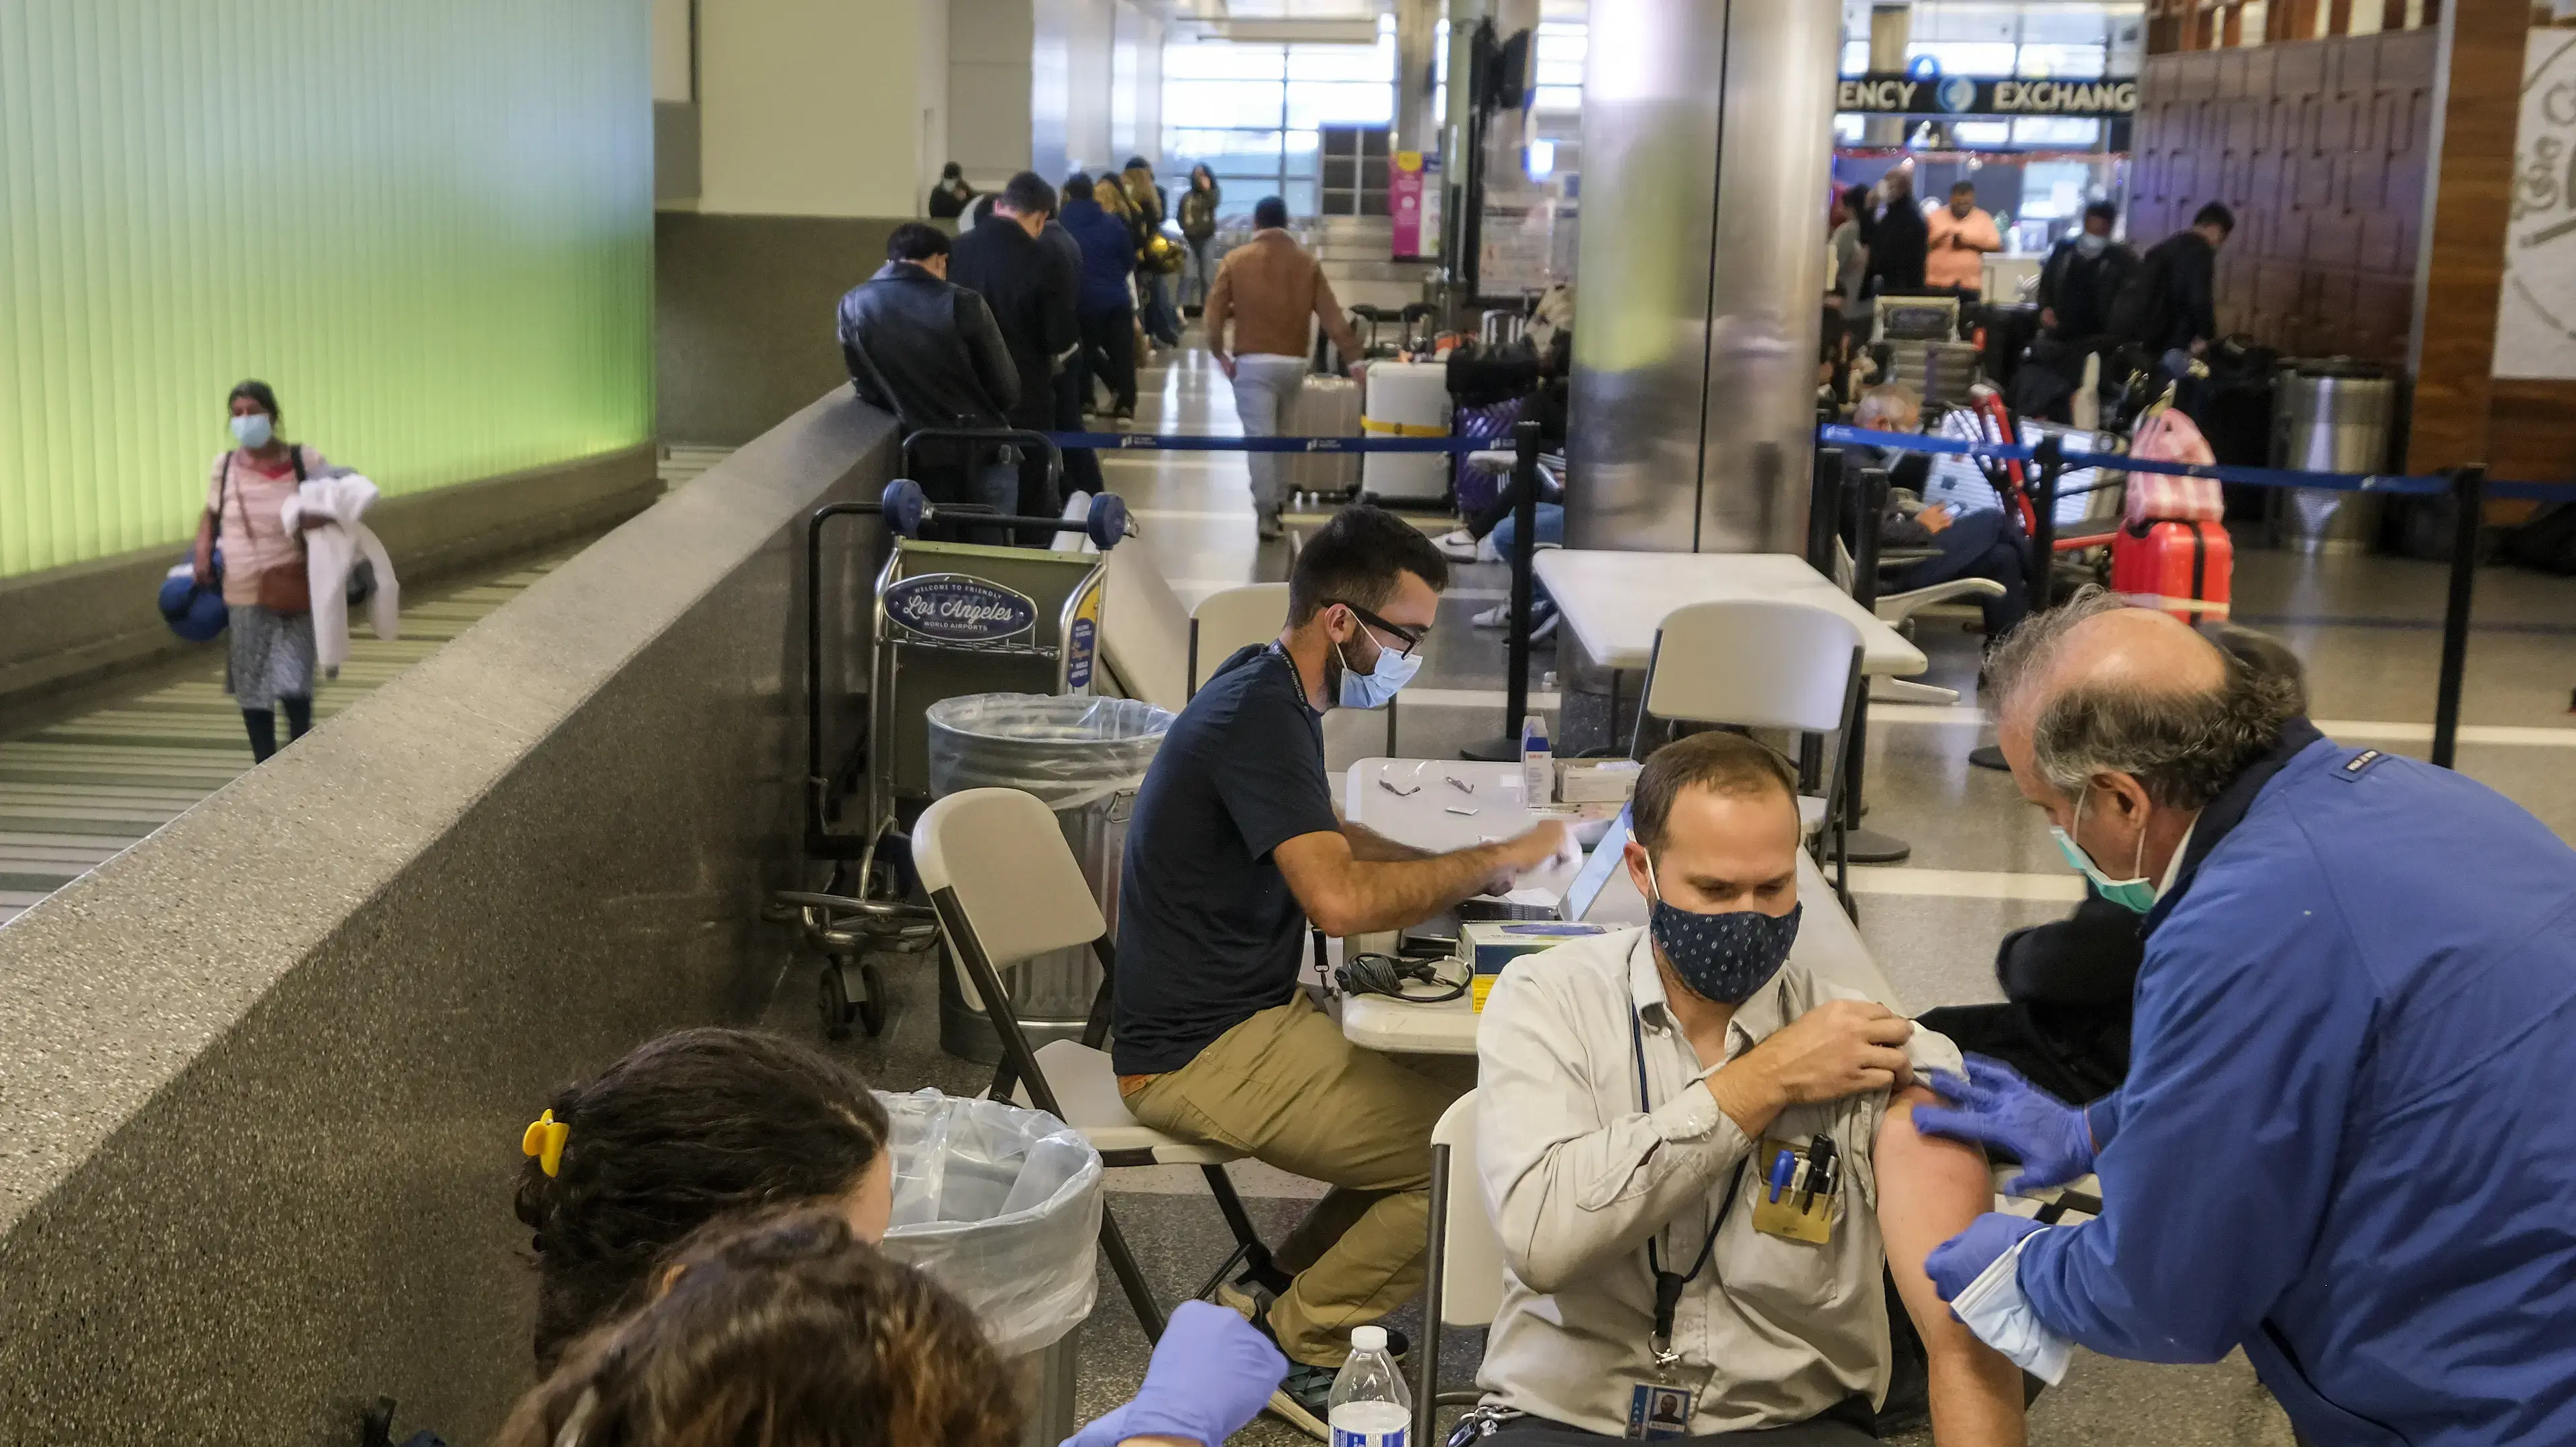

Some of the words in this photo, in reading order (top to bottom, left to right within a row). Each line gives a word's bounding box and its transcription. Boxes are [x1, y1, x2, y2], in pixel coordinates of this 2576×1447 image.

[1837, 81, 1917, 110] ENCY
[1992, 82, 2136, 111] EXCHANG
[914, 584, 949, 593] WELCOME
[965, 586, 1002, 599] FRIENDLY
[903, 595, 936, 619] Los
[941, 600, 1013, 624] Angeles
[950, 623, 987, 631] AIRPORTS
